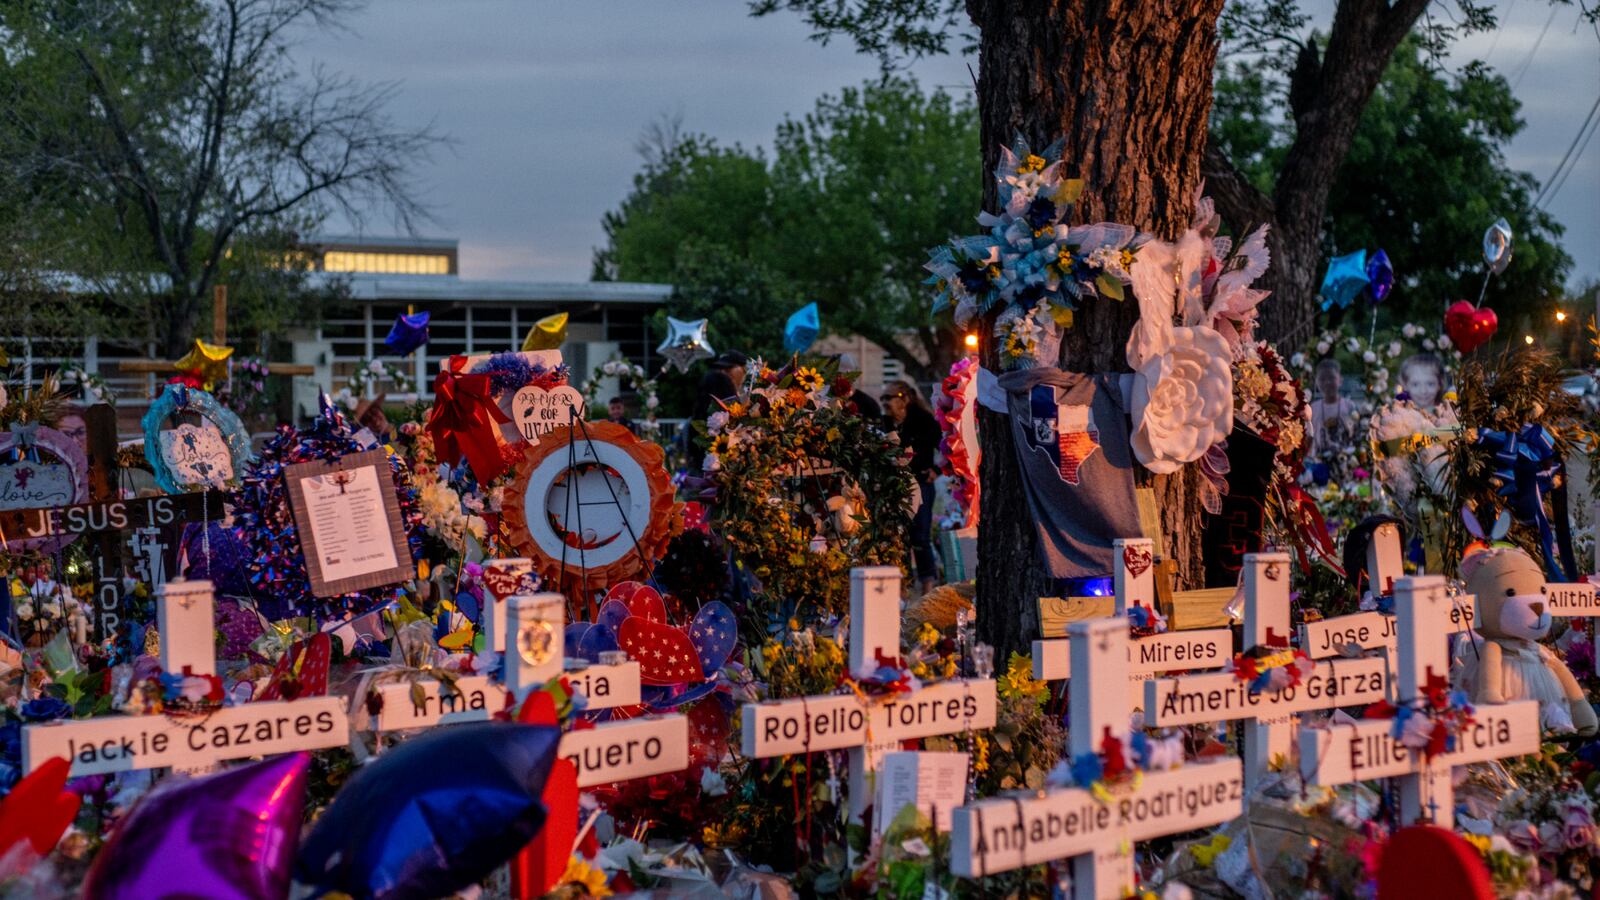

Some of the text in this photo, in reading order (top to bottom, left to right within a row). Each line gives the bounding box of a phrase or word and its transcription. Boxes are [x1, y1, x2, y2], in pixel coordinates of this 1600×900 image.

[524, 422, 572, 440] UVAL
[27, 498, 174, 538] JESUS IS
[98, 556, 120, 637] LOR
[1140, 640, 1217, 664] Mireles
[1321, 626, 1370, 651] Jose
[1161, 682, 1261, 718] Amerie
[1307, 670, 1383, 699] Garza
[67, 711, 334, 763] Jackie Cazares
[764, 695, 978, 746] Rojelio Torres
[1350, 718, 1511, 770] Ellie rcia
[976, 779, 1242, 854] Annabelle Rodriguez
